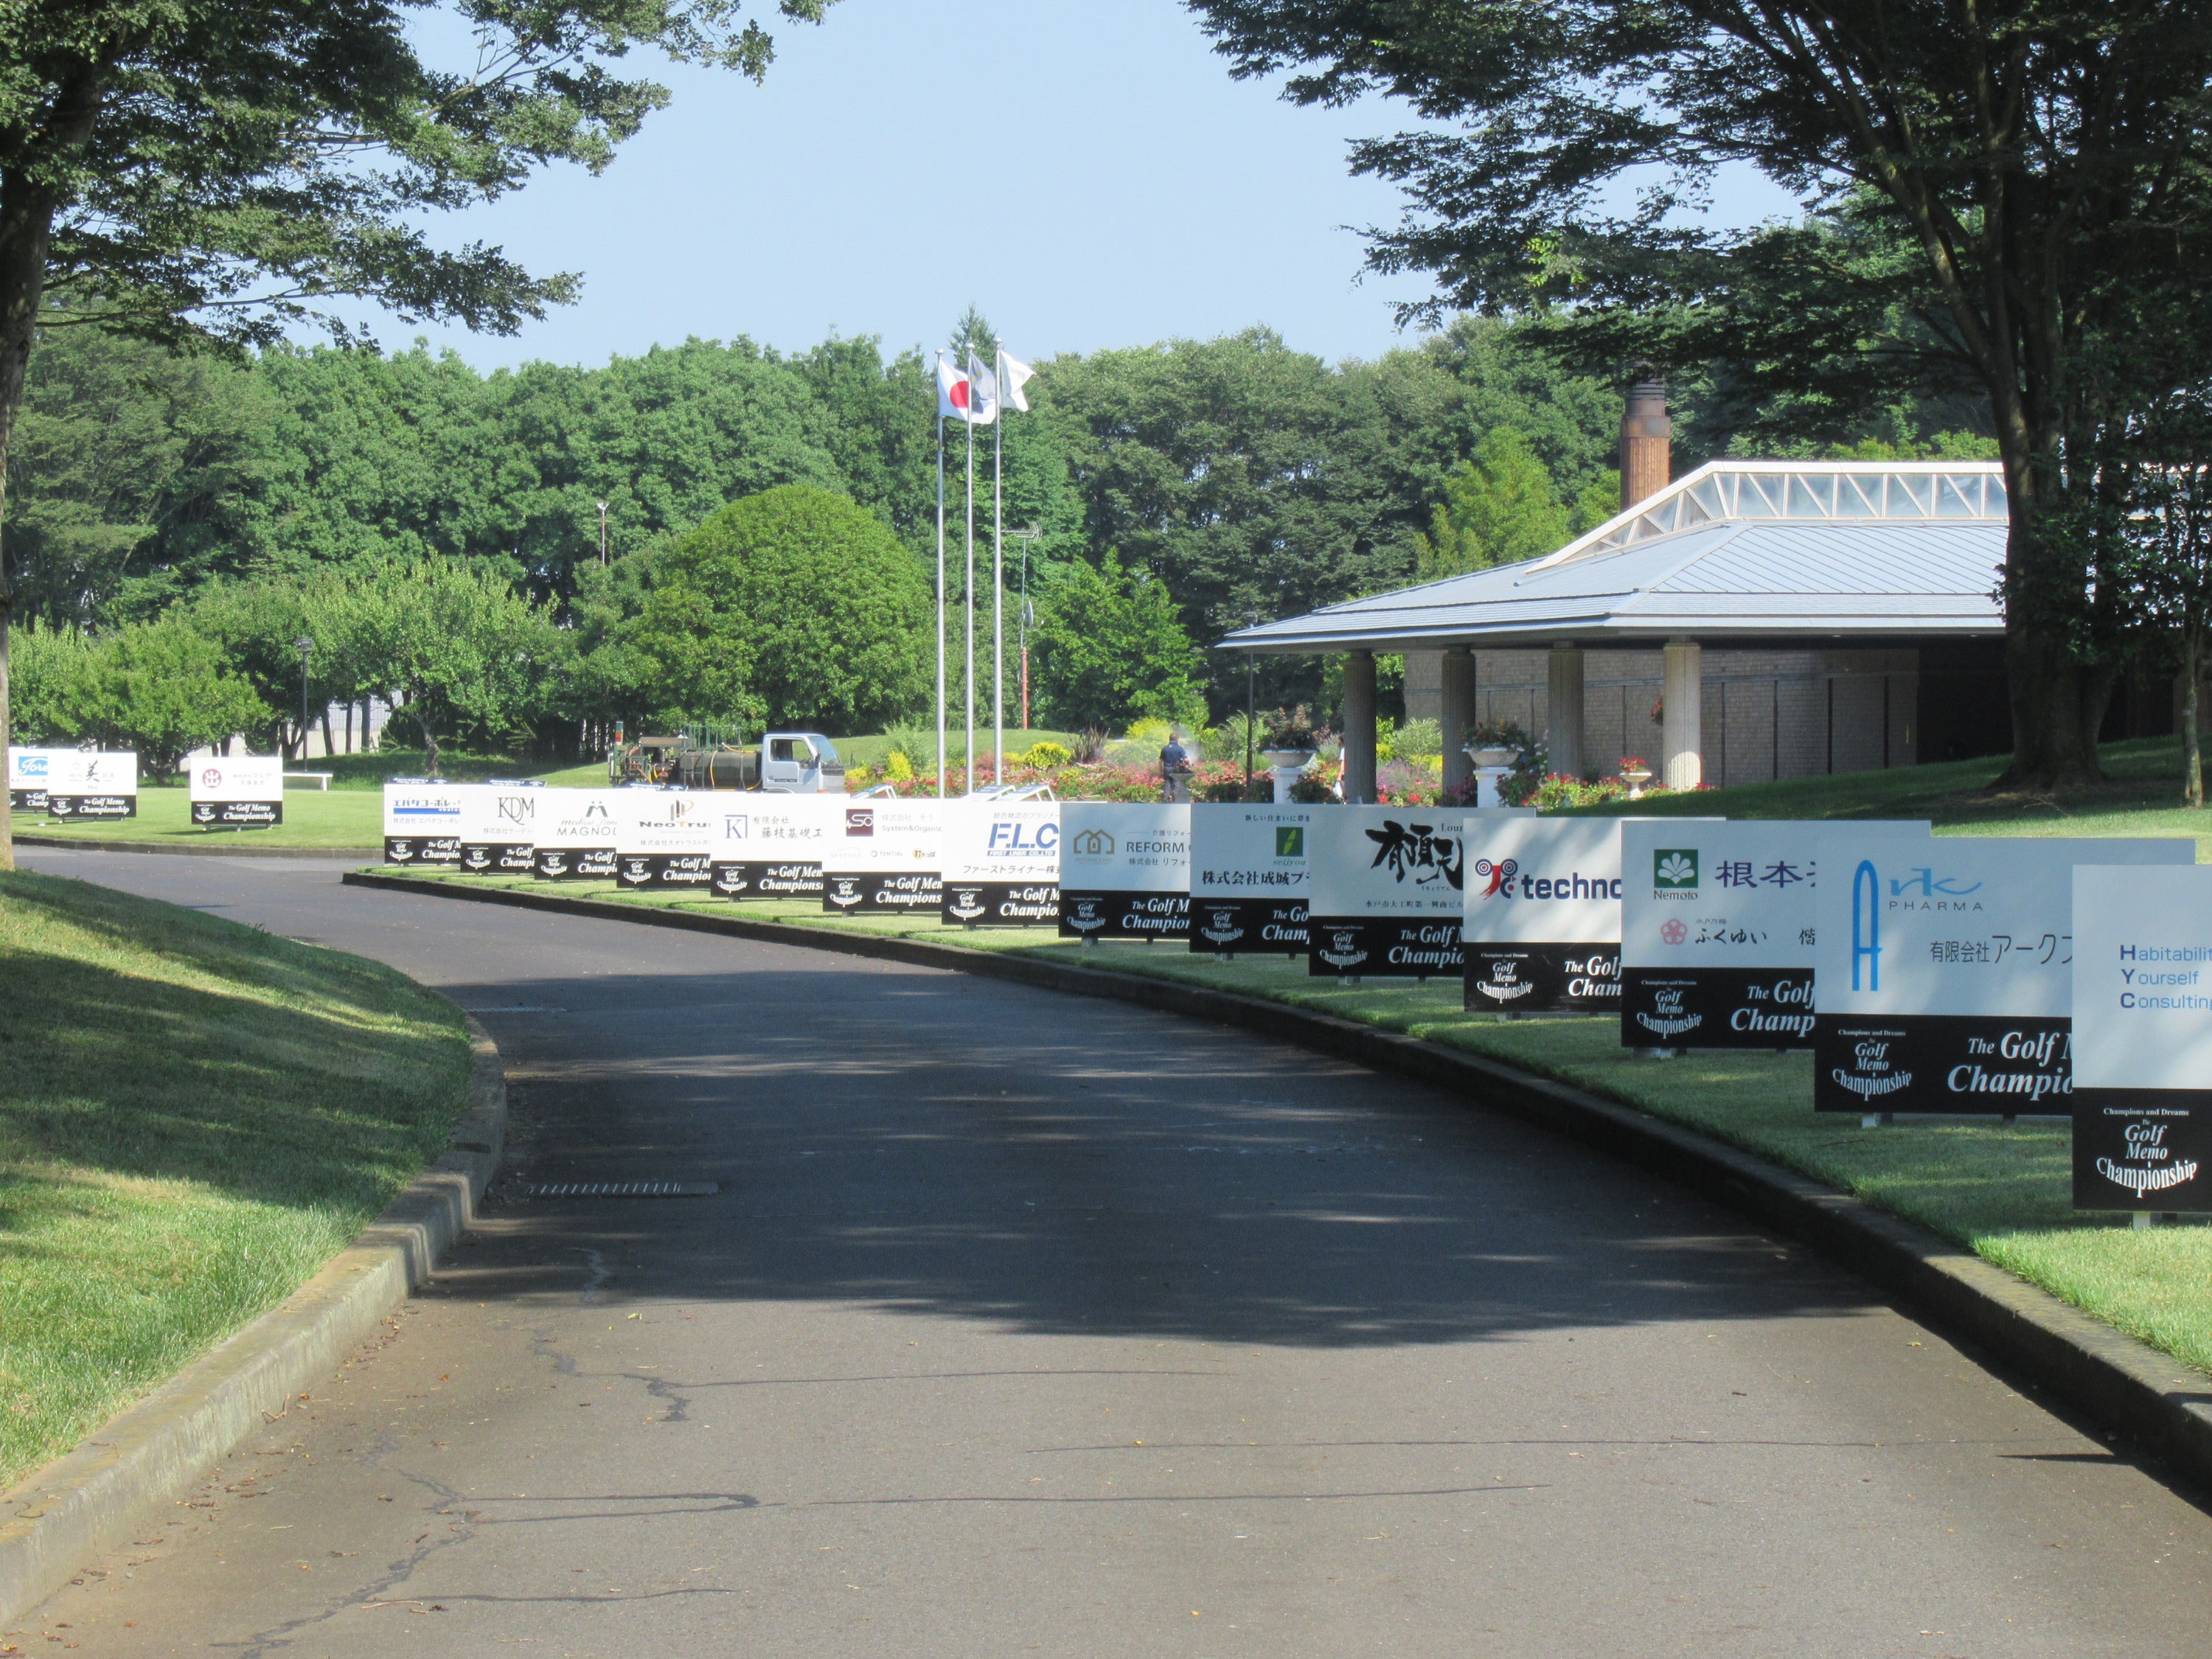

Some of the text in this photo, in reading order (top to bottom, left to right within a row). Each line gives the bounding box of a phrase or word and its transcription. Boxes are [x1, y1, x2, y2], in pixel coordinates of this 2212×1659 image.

[91, 798, 105, 808] Golf
[236, 804, 251, 813] Golf
[79, 805, 130, 815] Championship
[223, 812, 276, 821] Championship
[497, 797, 535, 826] KDM
[753, 815, 790, 824] 有限会社
[557, 826, 617, 836] MAGNOL
[437, 841, 454, 851] Golf
[516, 847, 535, 858] Golf
[1127, 841, 1184, 853] REFORM
[422, 850, 461, 860] Champio
[595, 852, 614, 864] Golf
[501, 858, 535, 869] Champi
[681, 858, 701, 870] Golf
[1129, 858, 1158, 866] 株式会社
[577, 863, 617, 875] Champi
[779, 866, 801, 879] Golf
[801, 866, 823, 877] Mem
[663, 870, 711, 883] Champio
[759, 879, 823, 893] Champions
[884, 877, 942, 891] The Golf Mem
[876, 891, 942, 906] Champions
[959, 894, 975, 902] Golf
[1009, 891, 1021, 899] The
[1023, 888, 1049, 904] Golf
[1653, 889, 1698, 900] Nemoto
[1000, 903, 1060, 919] Champio
[1078, 903, 1095, 912] Golf
[1133, 901, 1145, 910] The
[1147, 899, 1176, 915] Golf
[1889, 901, 1983, 911] PHARMA
[1213, 912, 1231, 922] Golf
[1273, 906, 1309, 922] The Go
[1067, 916, 1106, 933] Championship
[1122, 914, 1190, 932] Champio
[1201, 927, 1244, 945] Championship
[1333, 933, 1354, 944] Golf
[1401, 926, 1455, 947] The Golf
[1695, 928, 1767, 945] ふくゆい
[1334, 942, 1354, 951] Memo
[2120, 945, 2212, 961] Habitabilit
[1320, 949, 1368, 970] Championship
[1388, 946, 1464, 968] Champi
[1492, 961, 1516, 974] Golf
[1565, 961, 1583, 973] The
[1493, 973, 1517, 983] Memo
[2121, 968, 2199, 985] Yourself
[1477, 981, 1533, 1004] Championship
[1655, 991, 1683, 1004] Golf
[1747, 986, 1769, 1000] The
[1656, 1003, 1683, 1014] Memo
[1637, 1012, 1702, 1039] Championship
[1854, 1043, 1888, 1060] Golf
[1969, 1038, 1994, 1054] The
[2000, 1032, 2059, 1066] Golf
[1855, 1058, 1889, 1071] Memo
[1832, 1068, 1911, 1101] Championship
[1947, 1065, 2072, 1101] Champi
[2104, 1107, 2144, 1116] Champions
[2124, 1124, 2167, 1146] Golf
[2126, 1142, 2168, 1159] Memo
[2096, 1157, 2197, 1198] Championship
